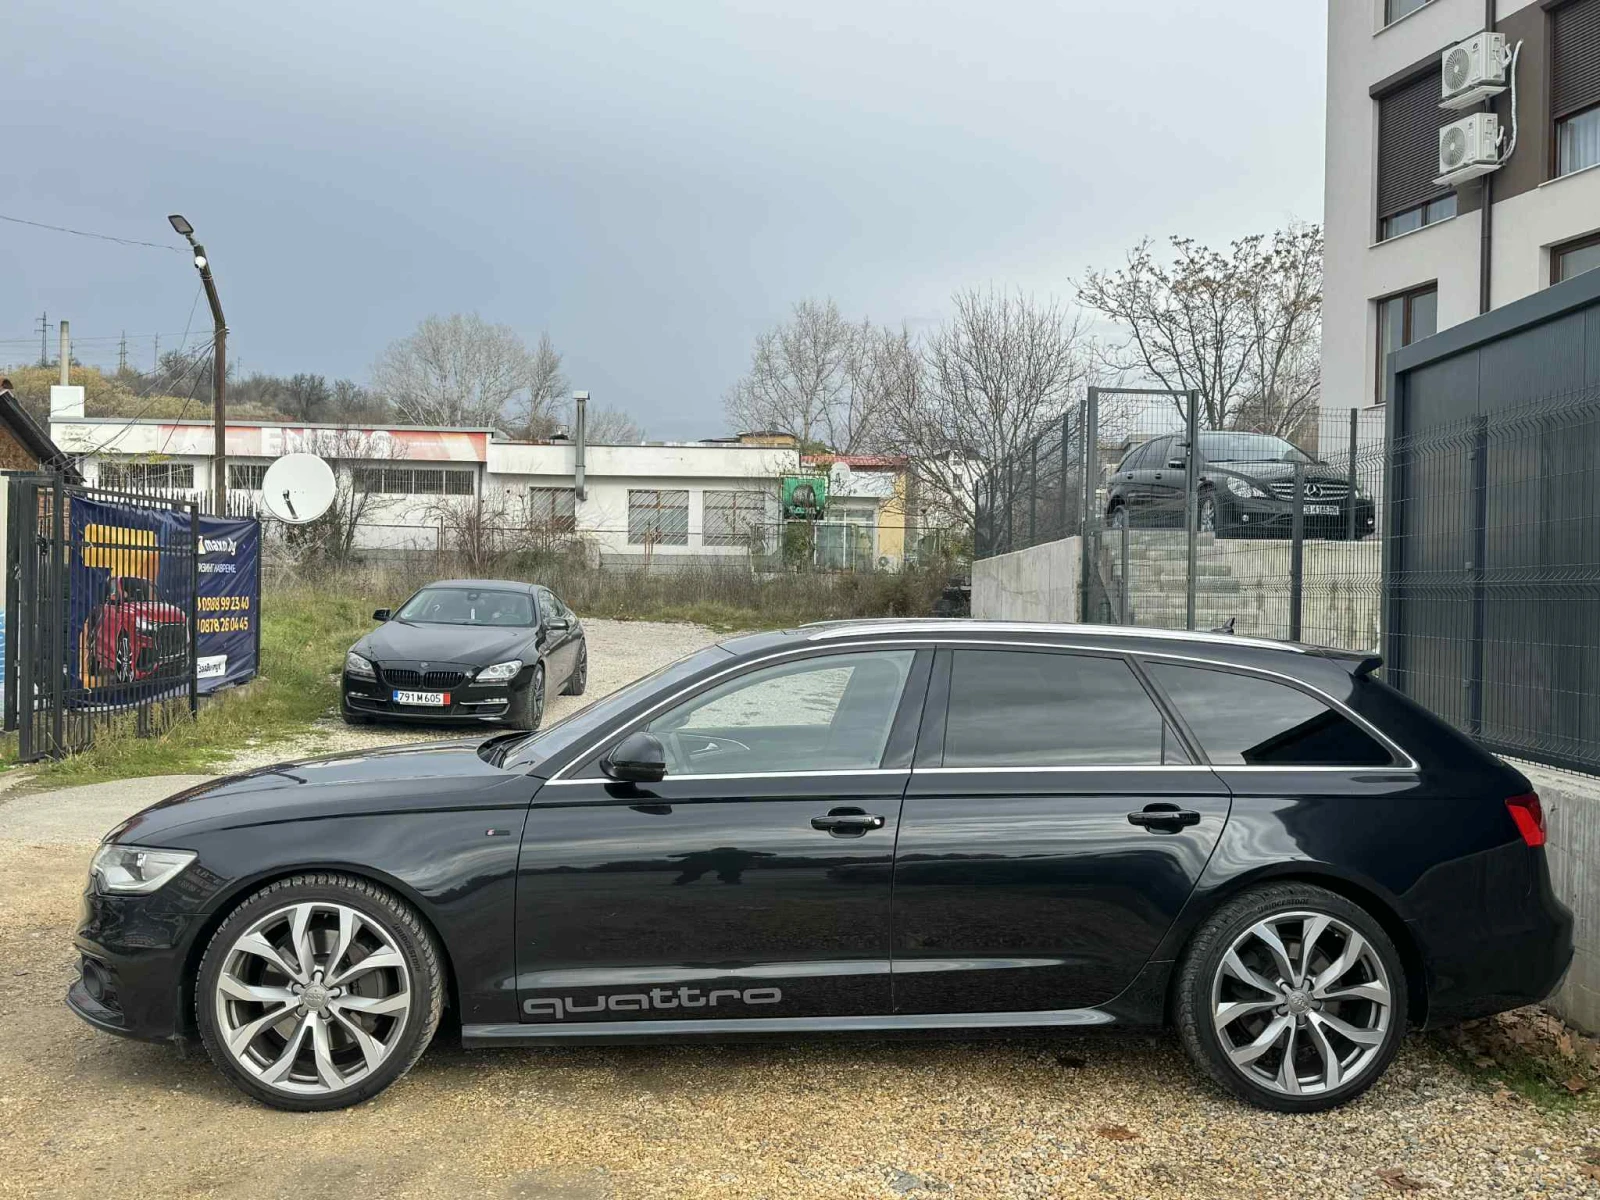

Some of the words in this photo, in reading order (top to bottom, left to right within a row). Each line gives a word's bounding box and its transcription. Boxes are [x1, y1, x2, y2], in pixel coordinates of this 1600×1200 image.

[220, 596, 230, 610] 99
[230, 596, 240, 610] 23
[241, 596, 249, 610] 40
[200, 618, 220, 633] 0878
[230, 617, 239, 631] 04
[239, 616, 248, 631] 45
[523, 987, 782, 1019] quattro
